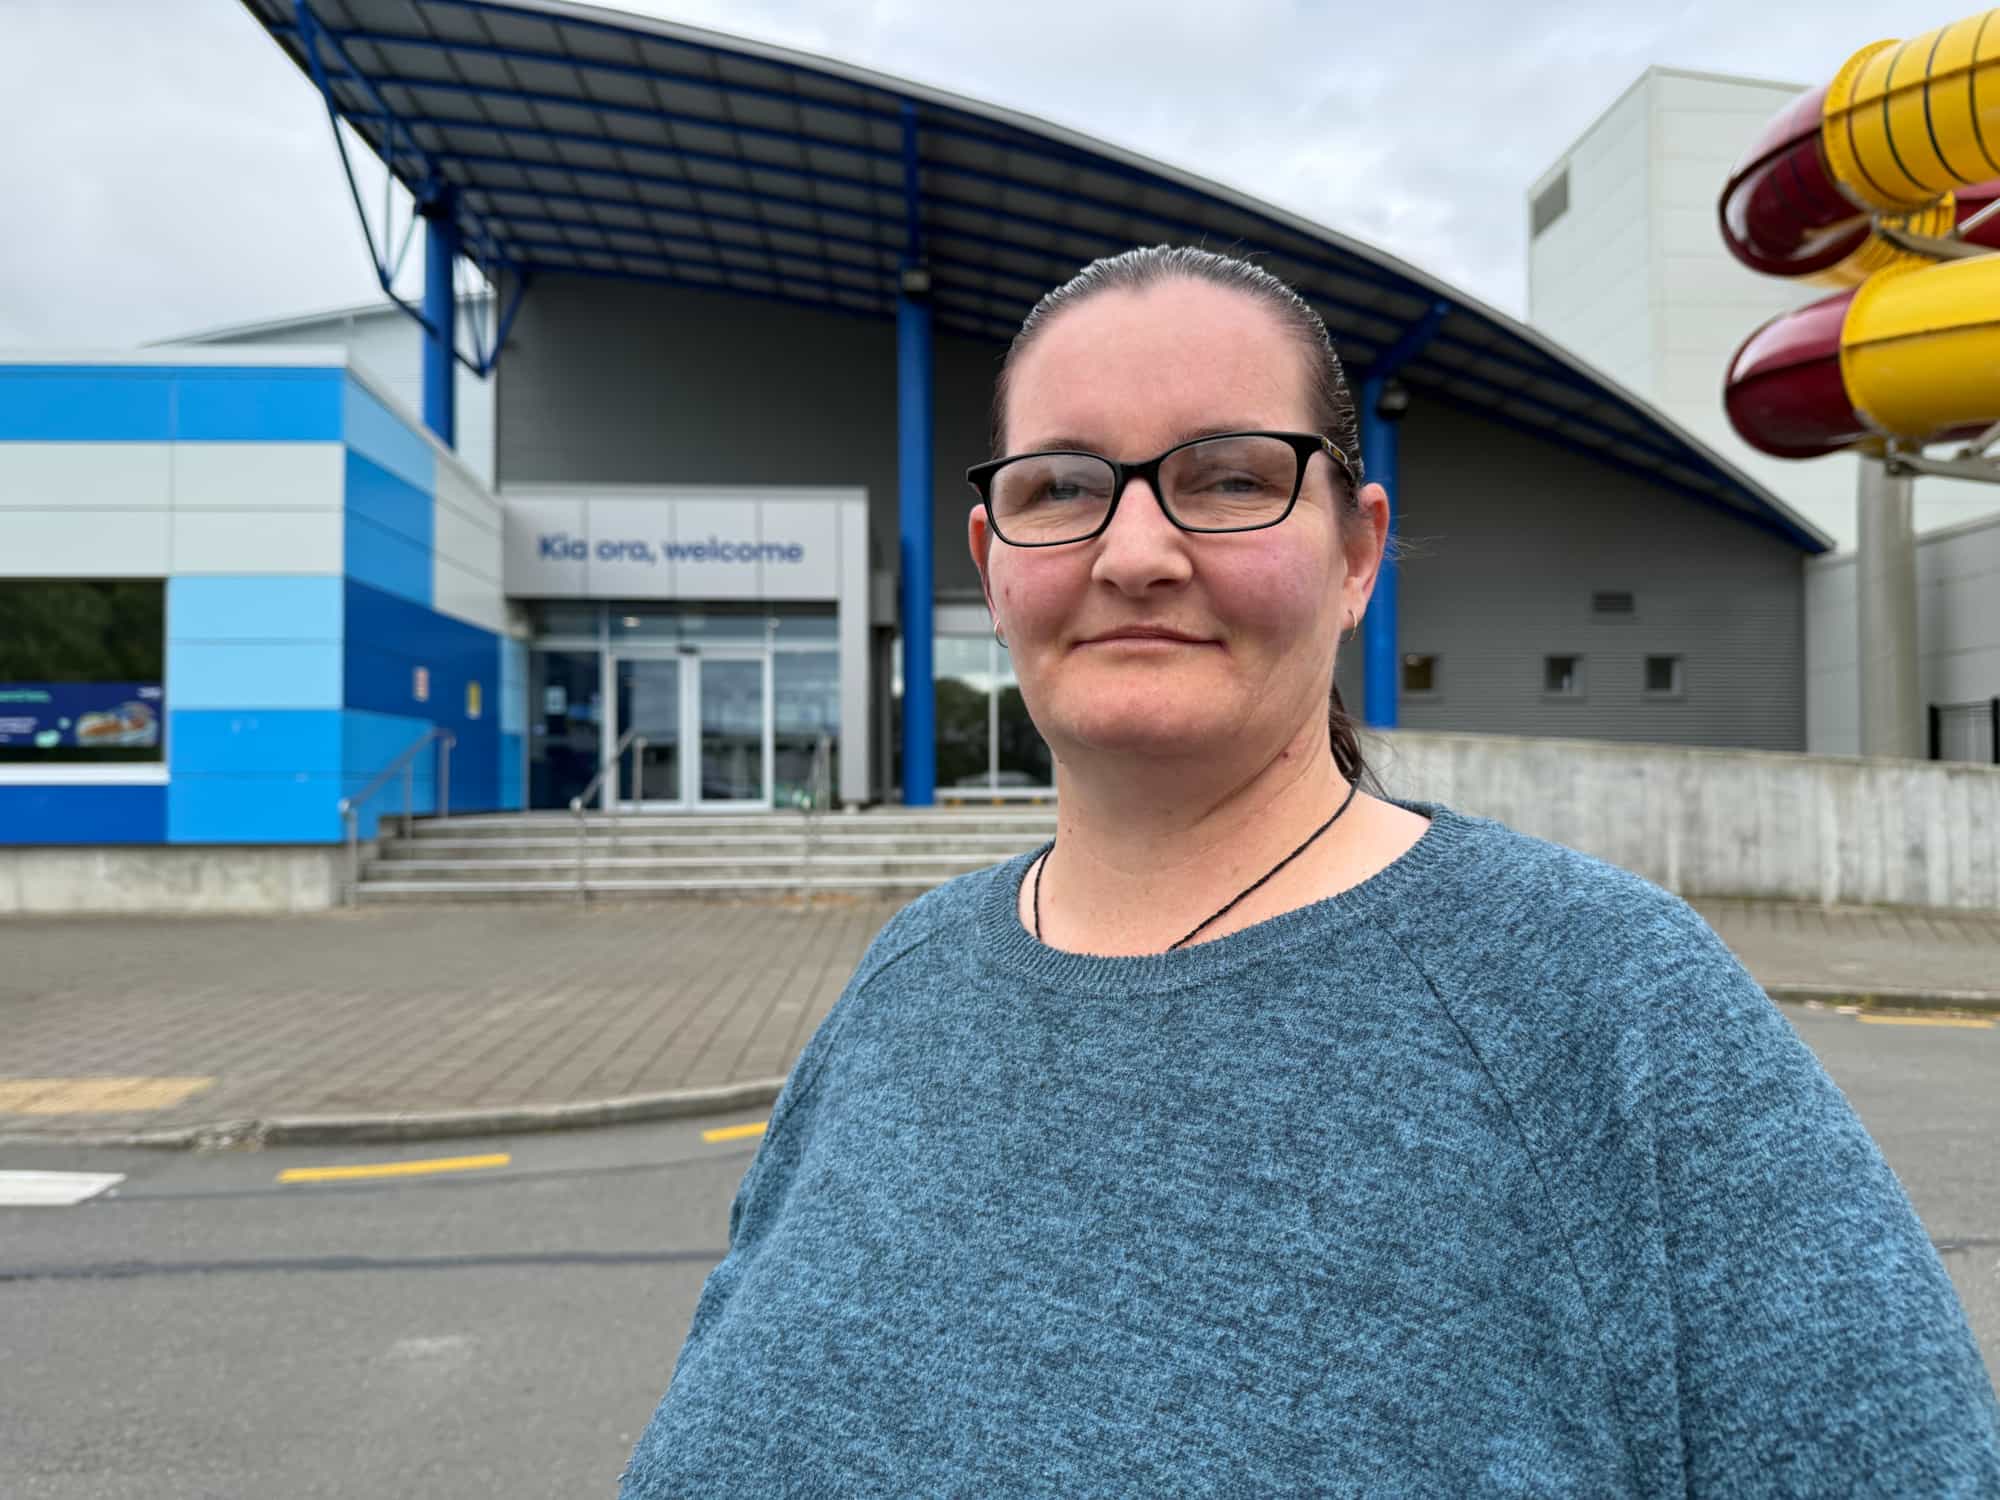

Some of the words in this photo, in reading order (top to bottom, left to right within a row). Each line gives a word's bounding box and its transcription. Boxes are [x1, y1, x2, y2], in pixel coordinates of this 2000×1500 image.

[538, 533, 588, 561] Kia
[597, 538, 656, 564] ora,
[663, 535, 804, 563] welcome
